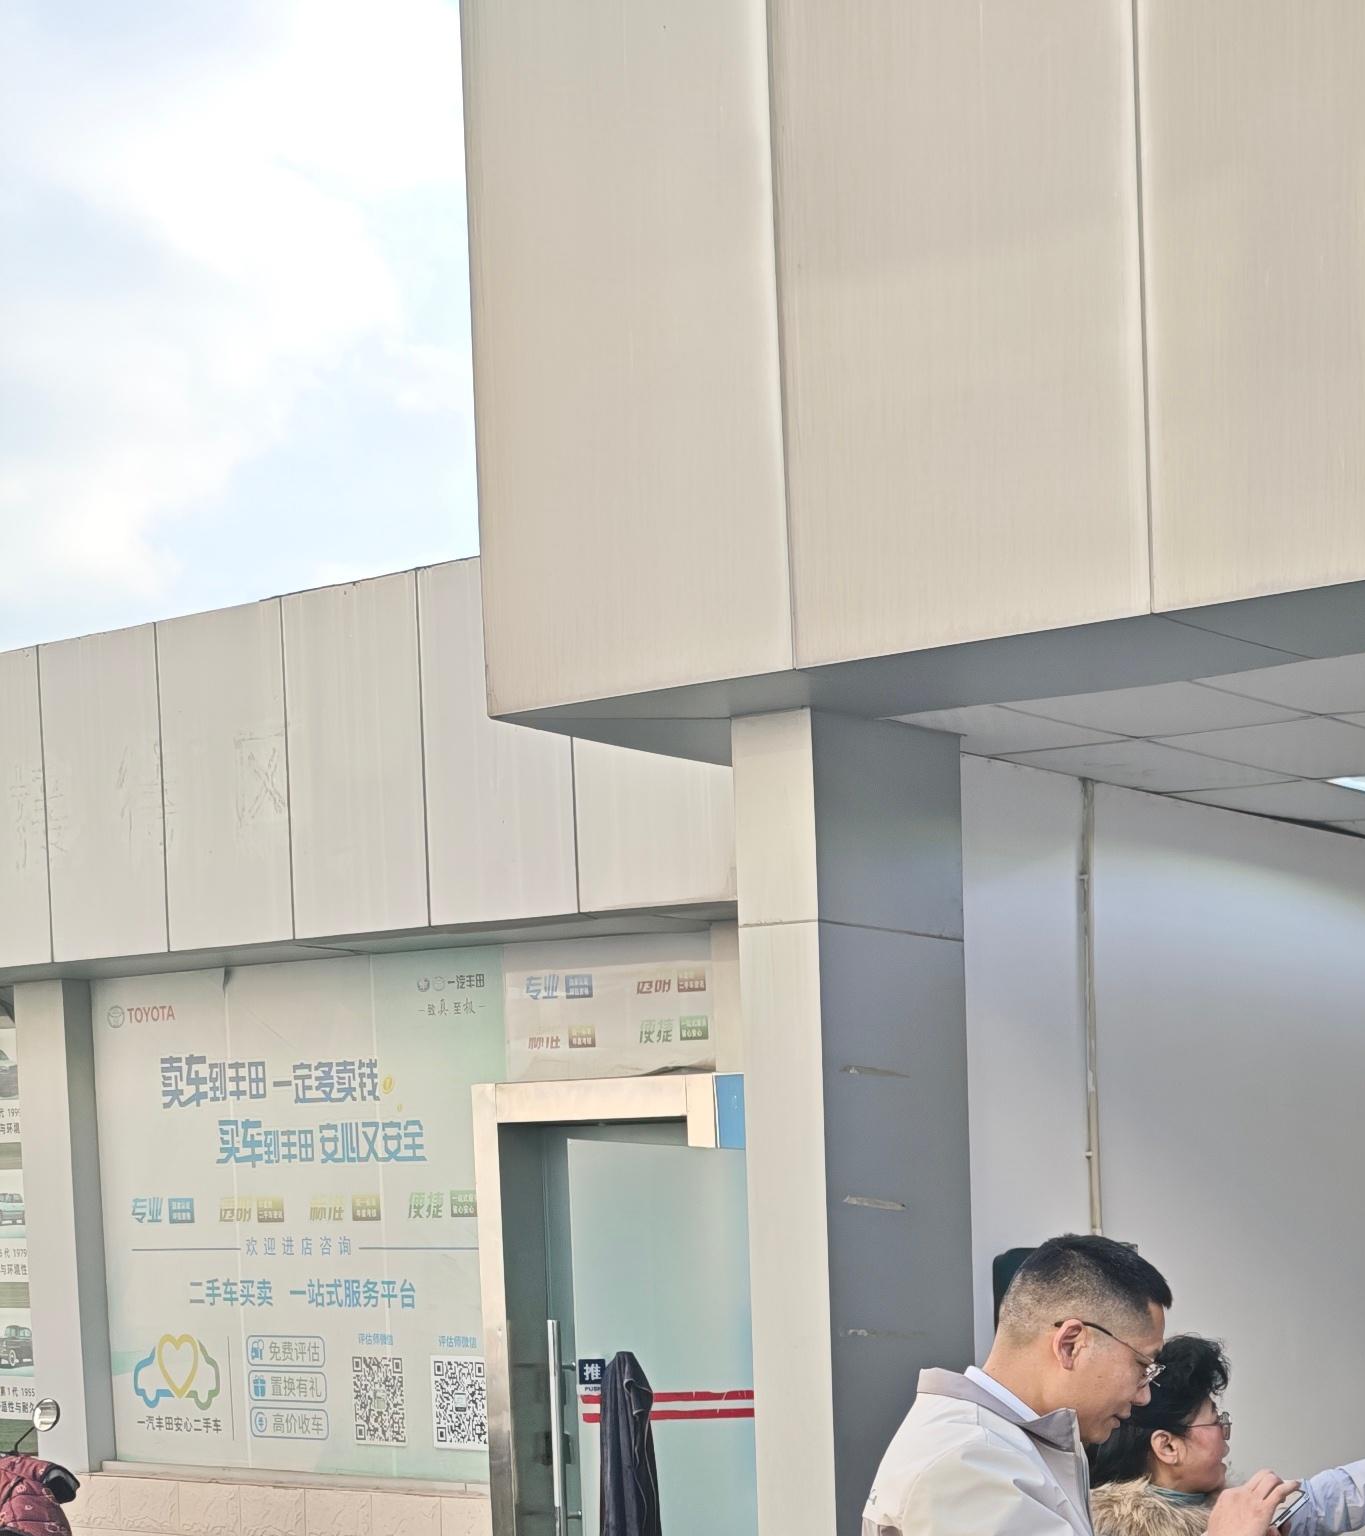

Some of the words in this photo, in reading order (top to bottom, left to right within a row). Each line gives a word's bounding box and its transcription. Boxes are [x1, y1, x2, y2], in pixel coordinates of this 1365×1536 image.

[127, 1005, 176, 1024] TOYOTA
[160, 1054, 267, 1109] 卖车到丰田
[272, 1058, 381, 1105] 一定多卖钱
[216, 1118, 315, 1168] 买车到丰田
[319, 1119, 428, 1164] 安心又安全
[245, 1235, 352, 1257] 欢迎进店咨询
[189, 1277, 274, 1307] 二手车买卖
[289, 1278, 417, 1310] 一站式服务平台
[268, 1340, 321, 1363] 免费评估
[583, 1363, 602, 1381] 推
[270, 1375, 322, 1398] 置换有礼
[136, 1415, 223, 1434] 一汽丰田安心二手车
[272, 1412, 325, 1435] 高价收车
